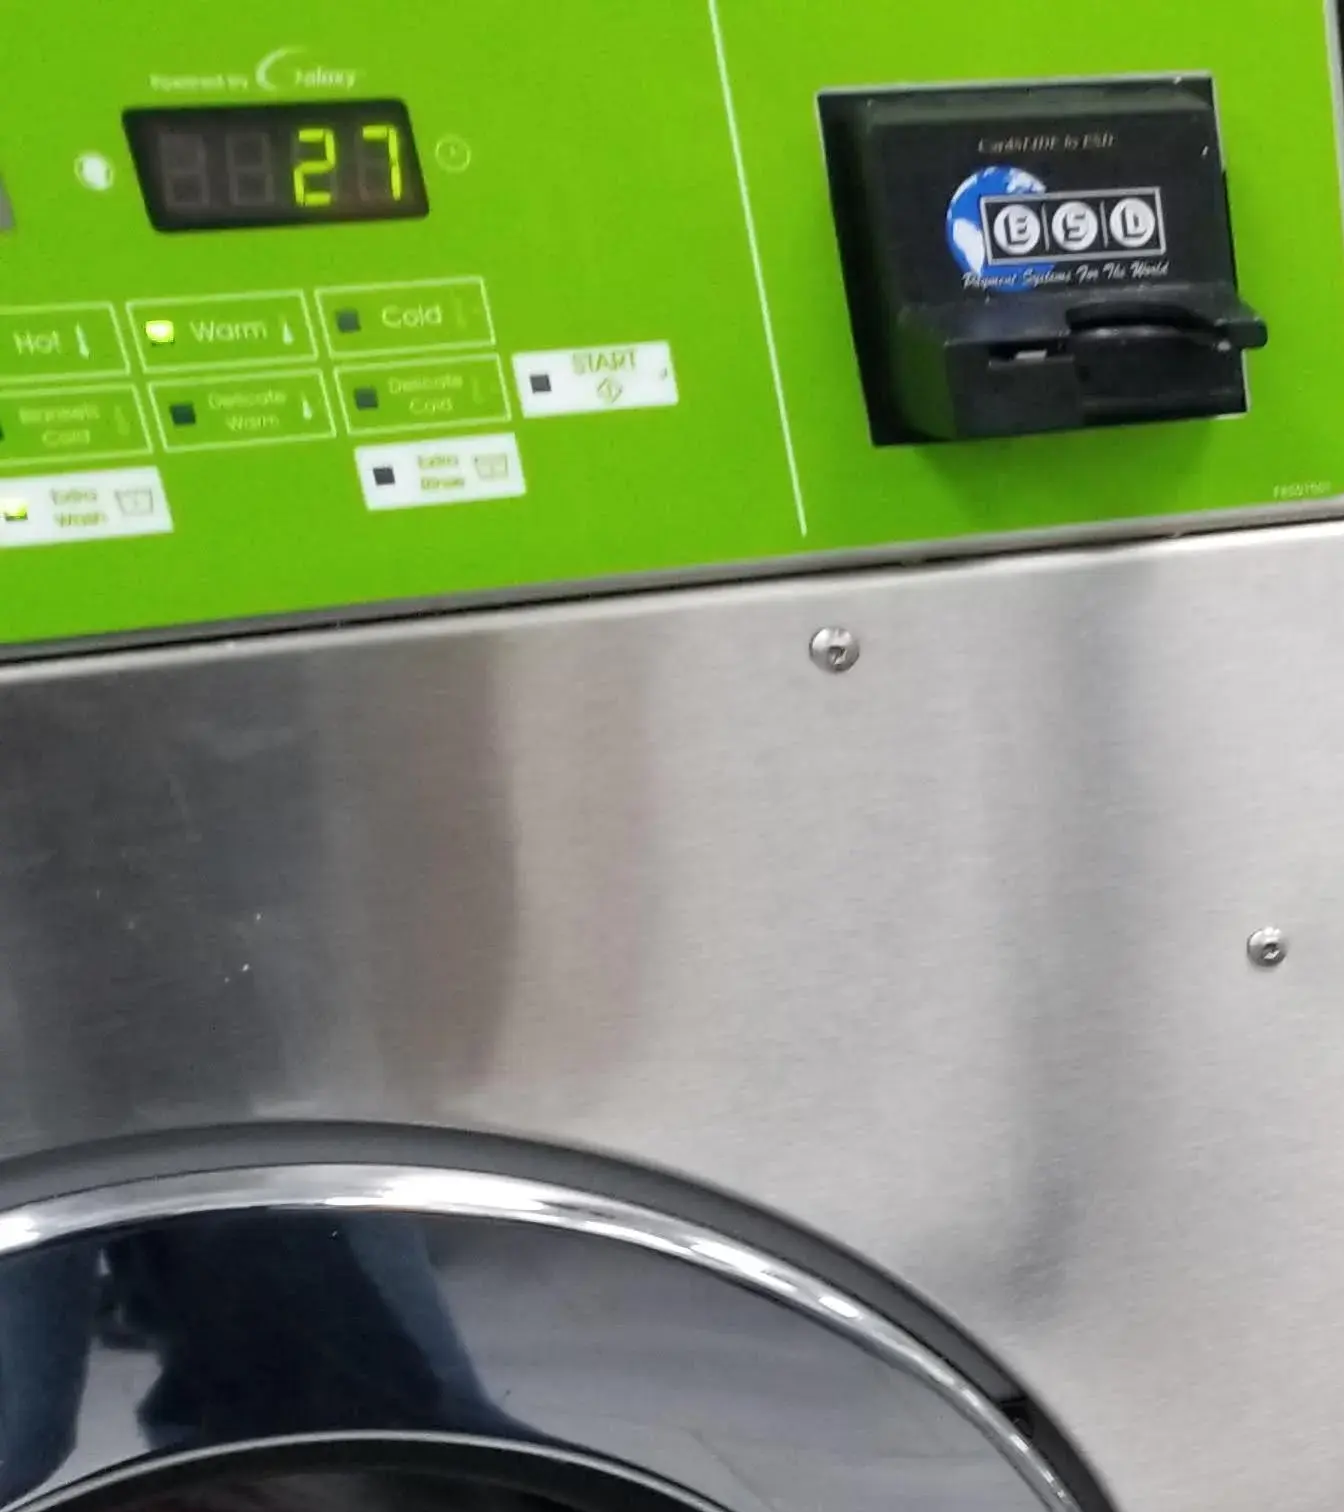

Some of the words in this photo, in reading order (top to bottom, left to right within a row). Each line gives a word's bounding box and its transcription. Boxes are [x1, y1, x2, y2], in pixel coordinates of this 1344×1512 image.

[294, 126, 401, 206] 27
[994, 198, 1156, 255] ESD
[1022, 267, 1072, 288] Systems
[1076, 263, 1098, 283] For
[1103, 260, 1125, 280] The
[1131, 258, 1169, 277] World
[381, 304, 442, 328] Cold
[190, 320, 268, 343] Warm
[571, 350, 637, 374] START
